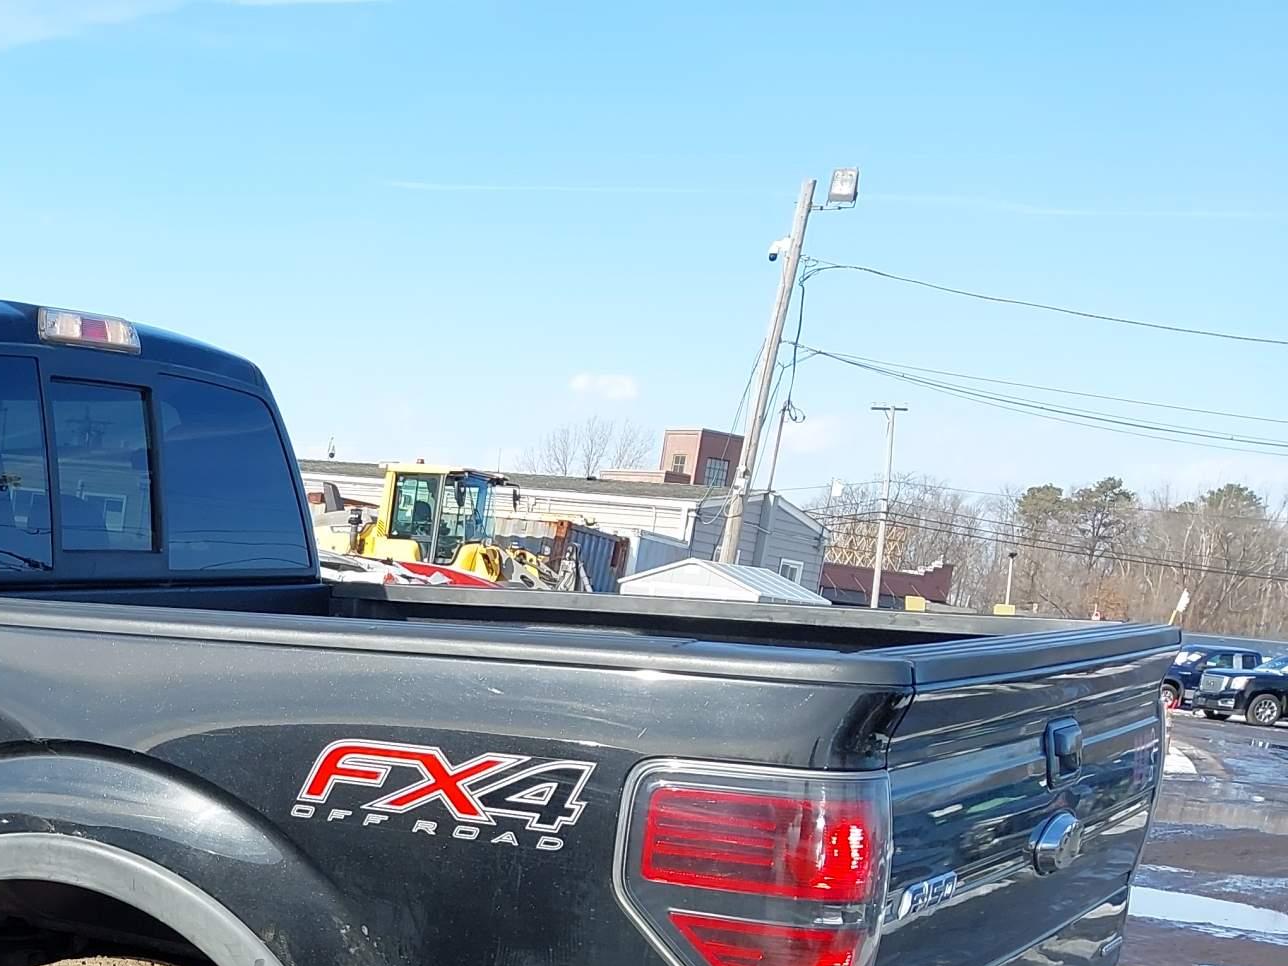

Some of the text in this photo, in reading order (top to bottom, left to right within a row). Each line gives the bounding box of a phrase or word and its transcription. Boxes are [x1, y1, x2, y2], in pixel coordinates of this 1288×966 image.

[296, 738, 597, 833] FX4
[290, 804, 565, 852] OFF ROAD
